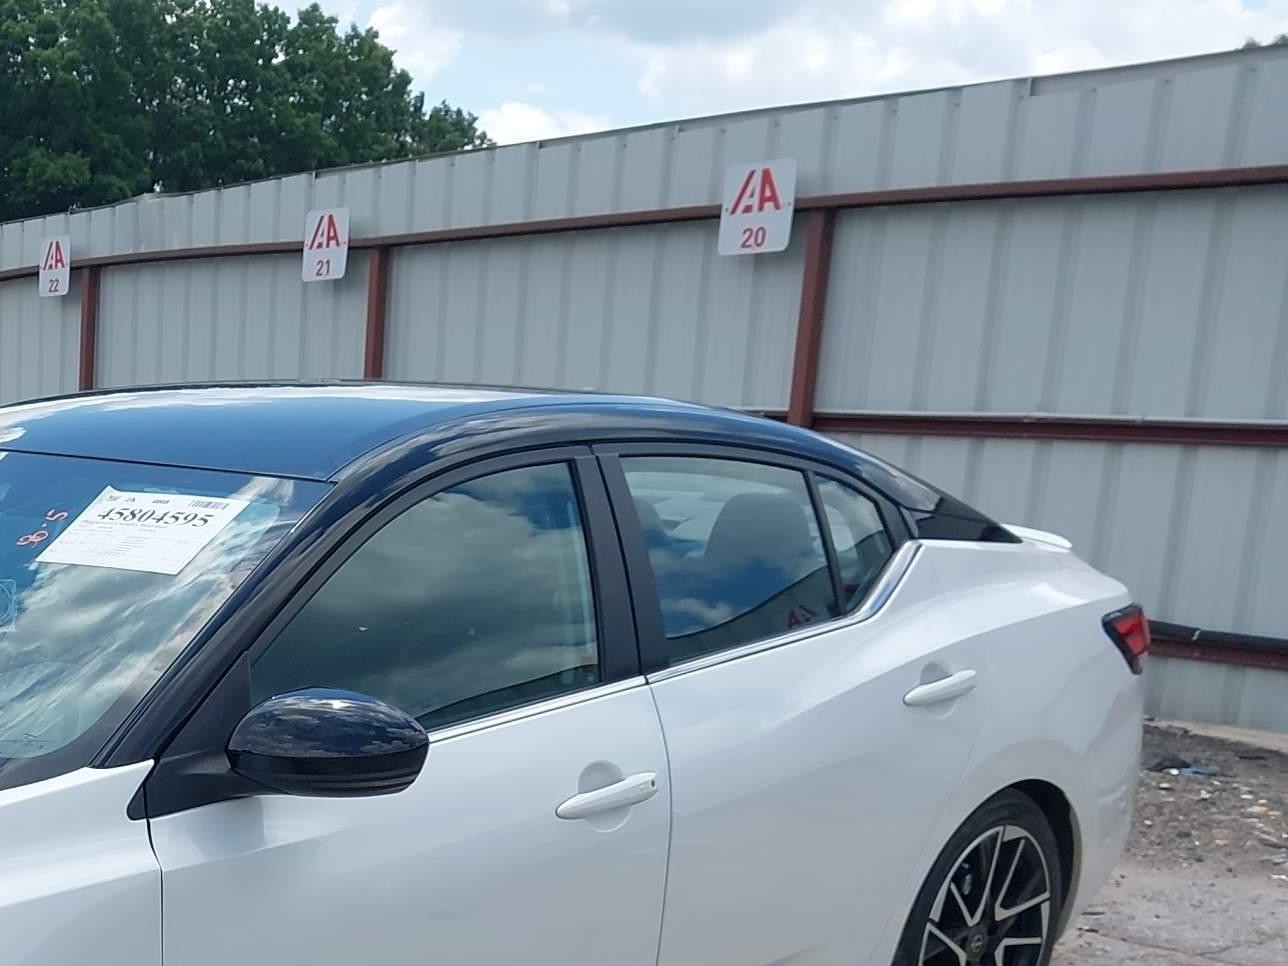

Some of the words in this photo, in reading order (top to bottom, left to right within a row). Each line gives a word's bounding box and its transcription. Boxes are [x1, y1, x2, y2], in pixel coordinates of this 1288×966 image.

[740, 226, 766, 248] 20
[315, 259, 330, 276] 21
[48, 278, 59, 292] 22
[96, 507, 215, 527] 45804595
